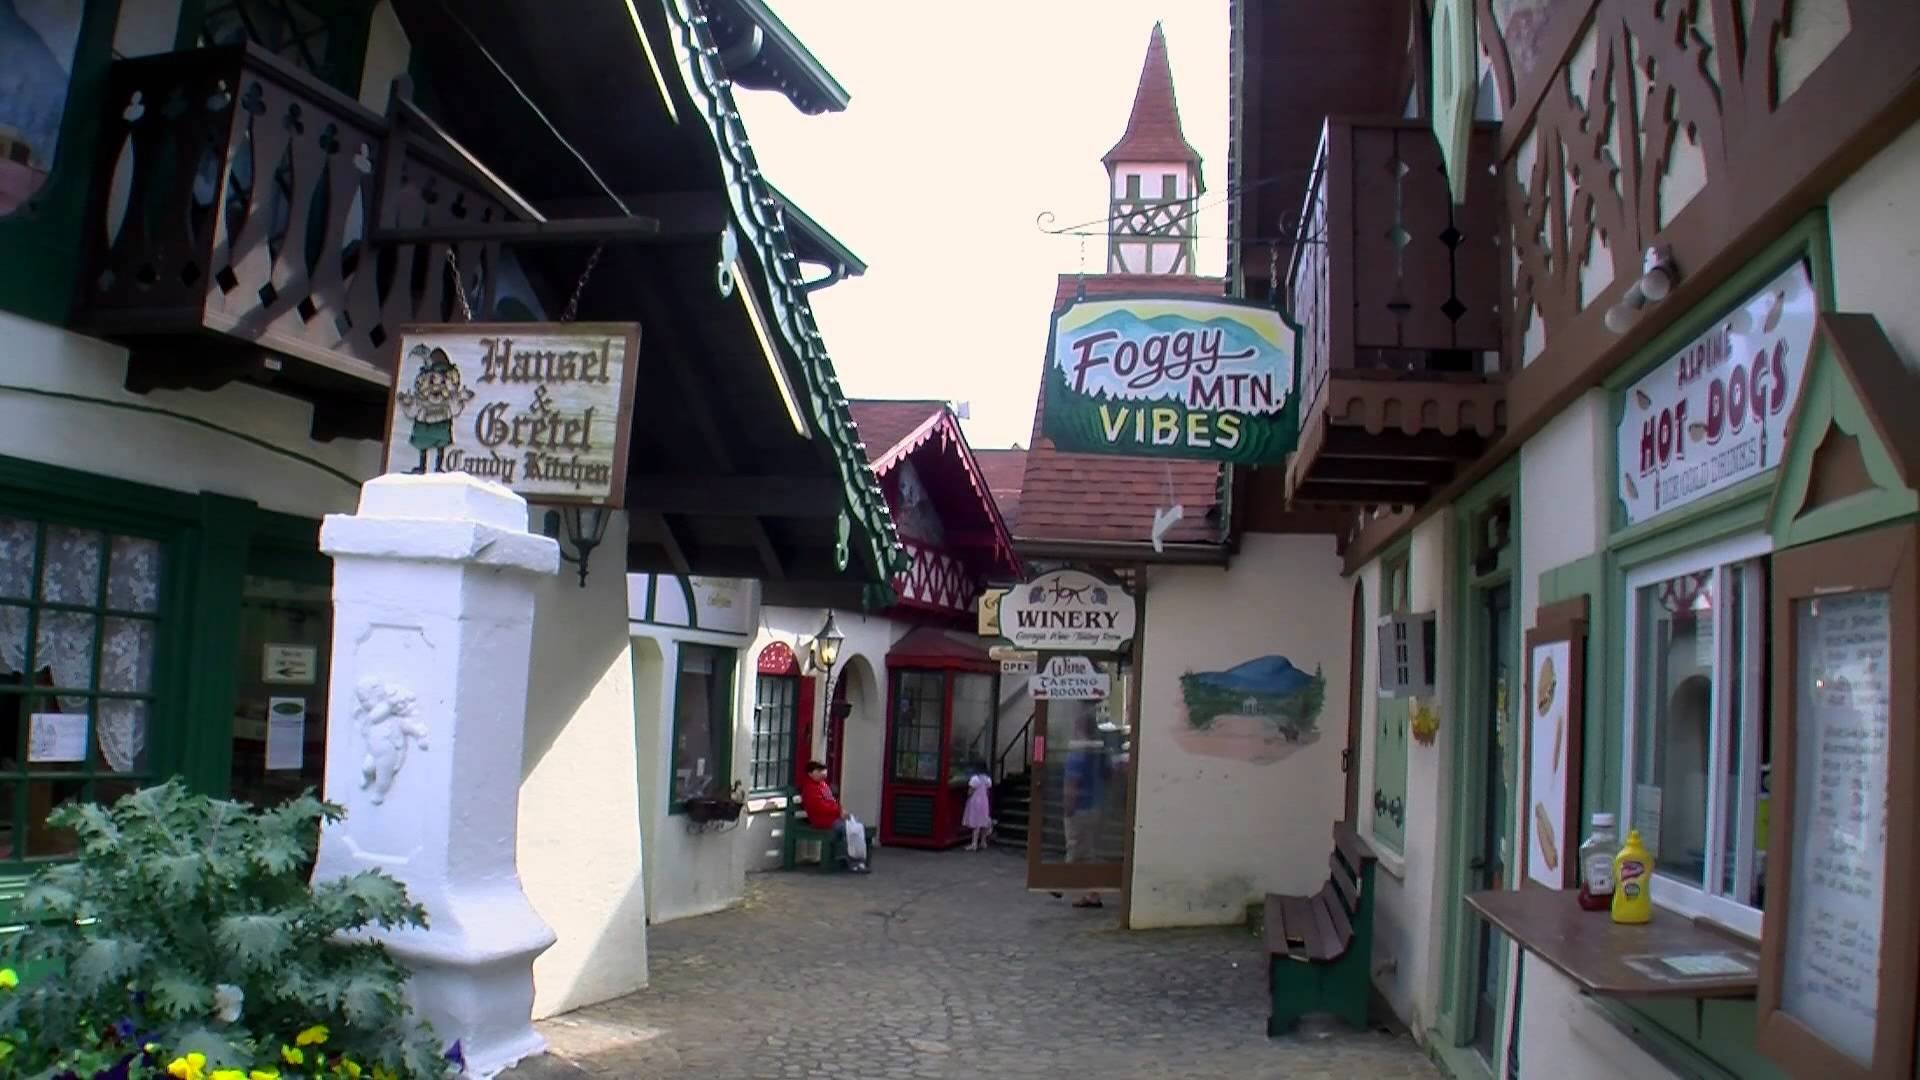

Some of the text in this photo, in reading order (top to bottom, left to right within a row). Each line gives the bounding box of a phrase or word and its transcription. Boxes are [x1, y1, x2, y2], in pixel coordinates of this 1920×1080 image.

[476, 338, 611, 384] Hansel
[1072, 328, 1256, 394] Foggy
[1678, 322, 1732, 387] ALPINE
[529, 384, 552, 413] &
[1640, 338, 1788, 476] HOT DOGS
[475, 401, 595, 450] Gretel
[1099, 404, 1241, 449] VIBES
[446, 450, 611, 489] Candy Kitchen
[1681, 462, 1709, 497] COLD
[1016, 610, 1120, 629] WINERY
[1003, 663, 1030, 671] OPEN
[1040, 677, 1098, 688] TASTING
[1052, 657, 1086, 677] Wine
[1050, 687, 1089, 697] ROOM
